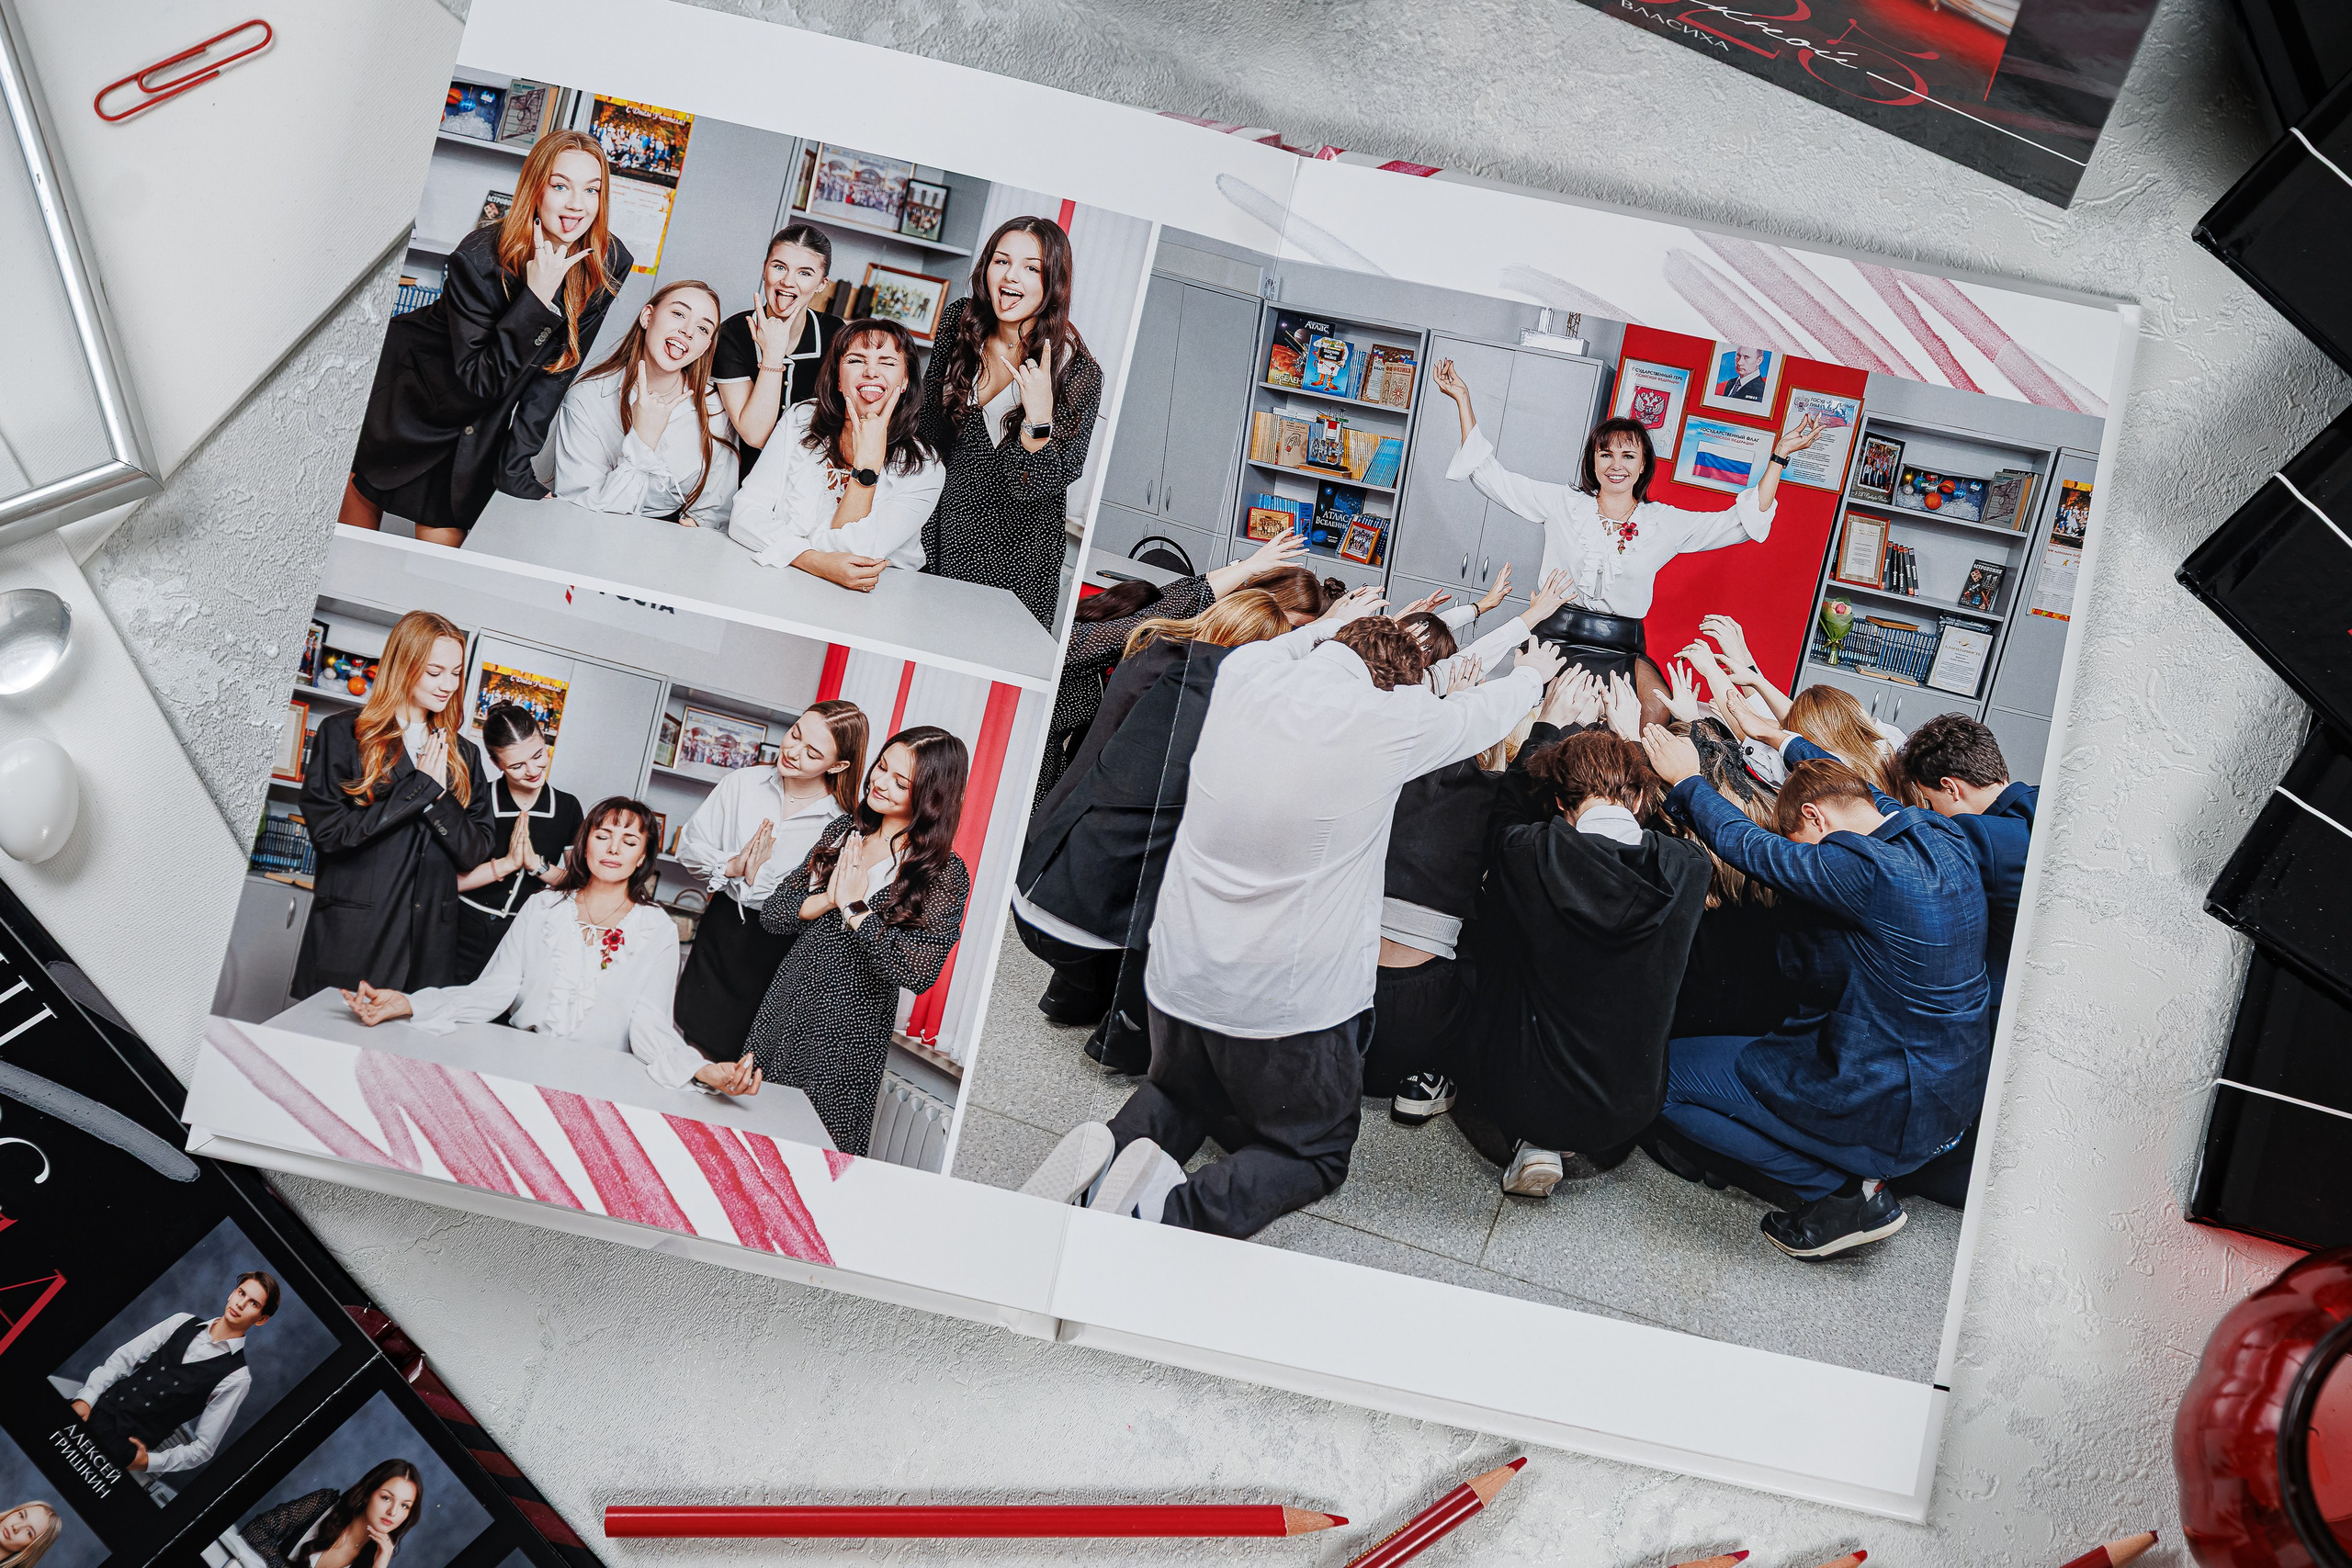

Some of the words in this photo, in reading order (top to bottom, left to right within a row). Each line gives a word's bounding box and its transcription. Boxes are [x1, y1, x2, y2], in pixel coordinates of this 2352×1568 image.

[1620, 0, 1730, 52] ВЛАСИХА
[1634, 0, 1940, 107] 25
[1689, 0, 1860, 70] кной
[49, 1430, 111, 1499] ГРИШКИН
[63, 1424, 122, 1484] АЛЕКСЕЙ
